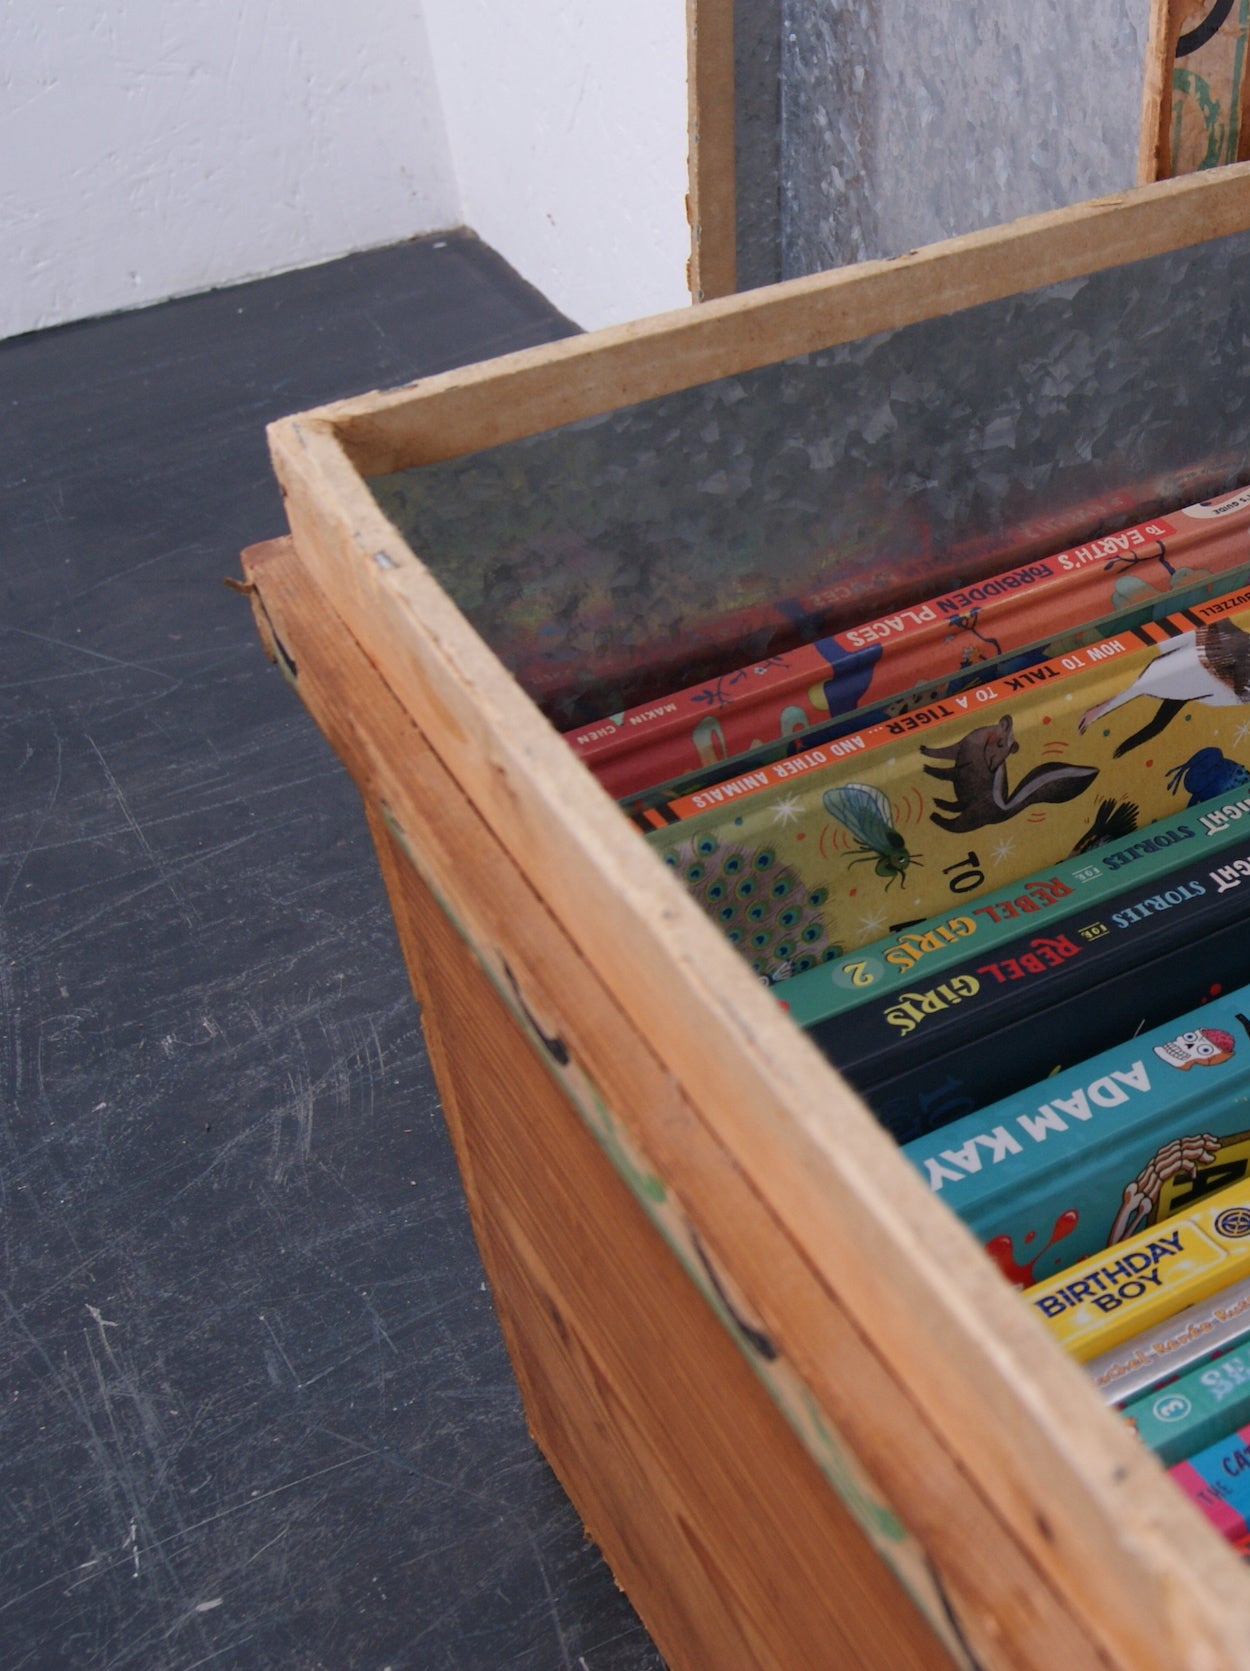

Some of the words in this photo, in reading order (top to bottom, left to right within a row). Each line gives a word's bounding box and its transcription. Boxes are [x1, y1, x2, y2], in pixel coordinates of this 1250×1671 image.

[1212, 502, 1239, 514] GUIDE
[1058, 529, 1145, 570] EARTH'S
[846, 605, 937, 647] PLACES
[1061, 655, 1086, 670] TO
[1086, 639, 1126, 662] HOW
[1004, 665, 1061, 691] TALK
[955, 695, 969, 710] A
[975, 686, 999, 702] TO
[629, 703, 677, 726] MAKIN
[577, 725, 616, 745] CHEN
[830, 735, 866, 757] AND
[772, 751, 827, 778] OTHER
[692, 771, 769, 809] ANIMALS
[1102, 825, 1196, 871] STORIES
[972, 877, 1076, 923] REBEL
[1111, 879, 1207, 930] STORIES
[976, 934, 1084, 983] REBEL
[843, 960, 875, 987] 2
[1015, 1060, 1152, 1142] ADAM
[923, 1126, 1024, 1192] KAY
[1034, 1230, 1185, 1319] BIRTHDAY
[1091, 1268, 1163, 1313] BOY
[1197, 1480, 1233, 1505] THE
